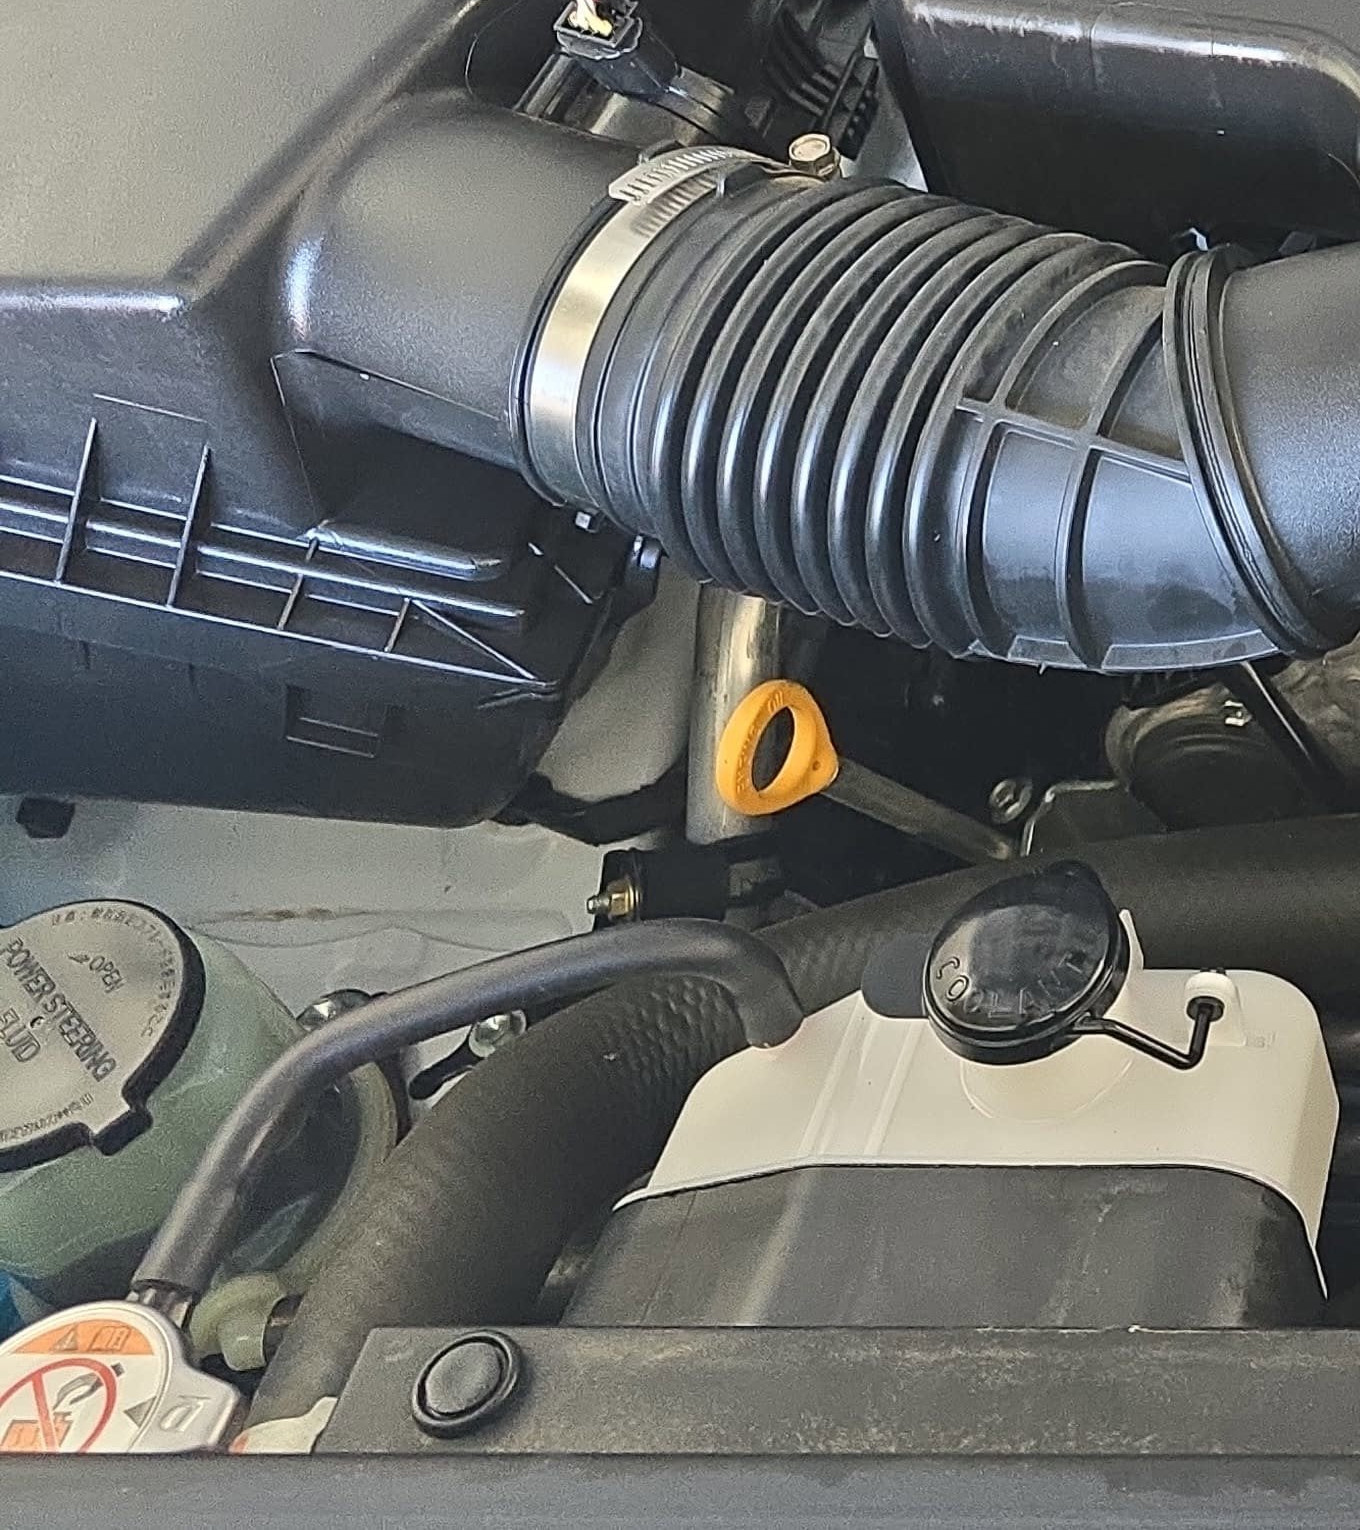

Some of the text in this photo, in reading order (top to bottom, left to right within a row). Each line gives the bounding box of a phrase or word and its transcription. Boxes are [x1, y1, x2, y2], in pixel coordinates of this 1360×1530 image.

[88, 956, 125, 994] OPEN
[0, 936, 57, 1005] POWER
[42, 992, 118, 1083] STEERING
[0, 1007, 41, 1063] FLUID
